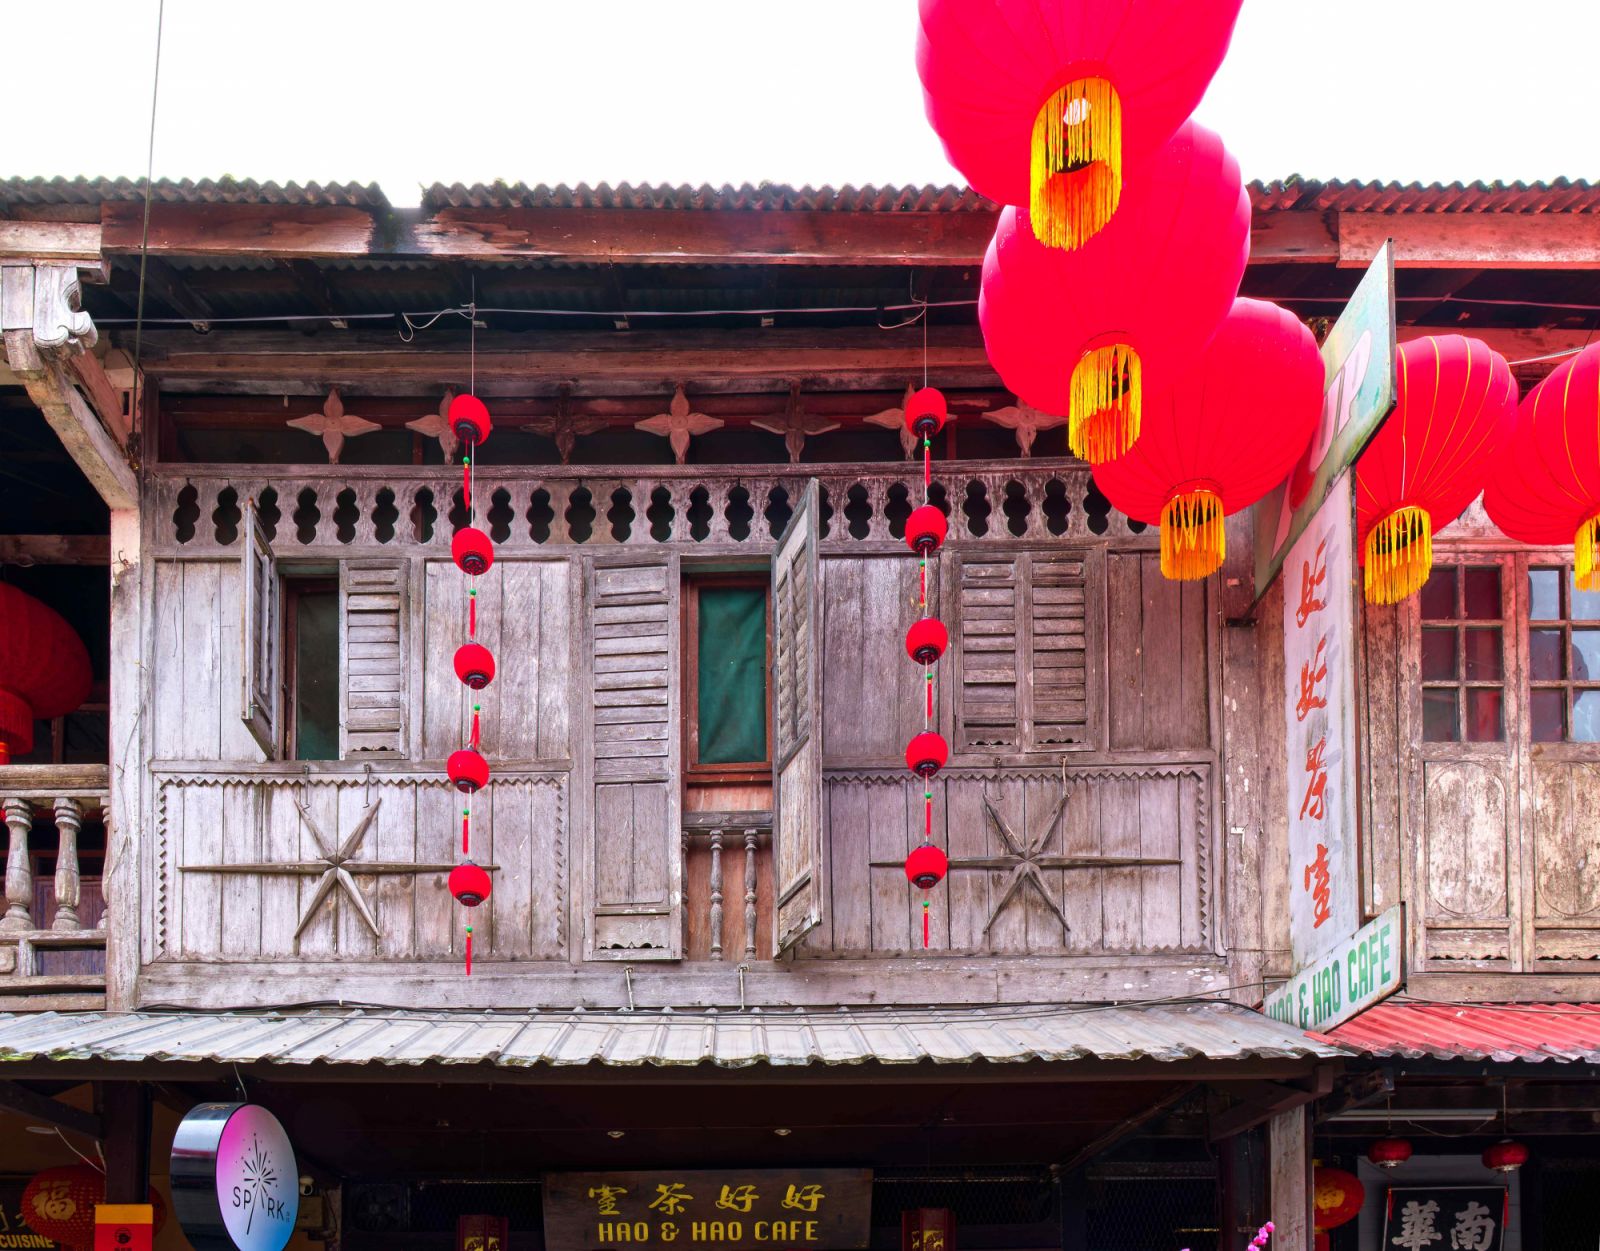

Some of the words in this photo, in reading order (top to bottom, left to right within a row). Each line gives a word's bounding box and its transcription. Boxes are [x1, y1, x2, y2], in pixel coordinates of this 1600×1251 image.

[1299, 982, 1309, 1030] &
[1313, 960, 1341, 1026] HAO
[1347, 923, 1391, 1004] CAFE
[0, 1234, 55, 1248] CUISINE
[598, 1222, 649, 1242] HAO
[661, 1222, 679, 1241] &
[692, 1221, 743, 1241] HAO
[754, 1220, 819, 1241] CAFE
